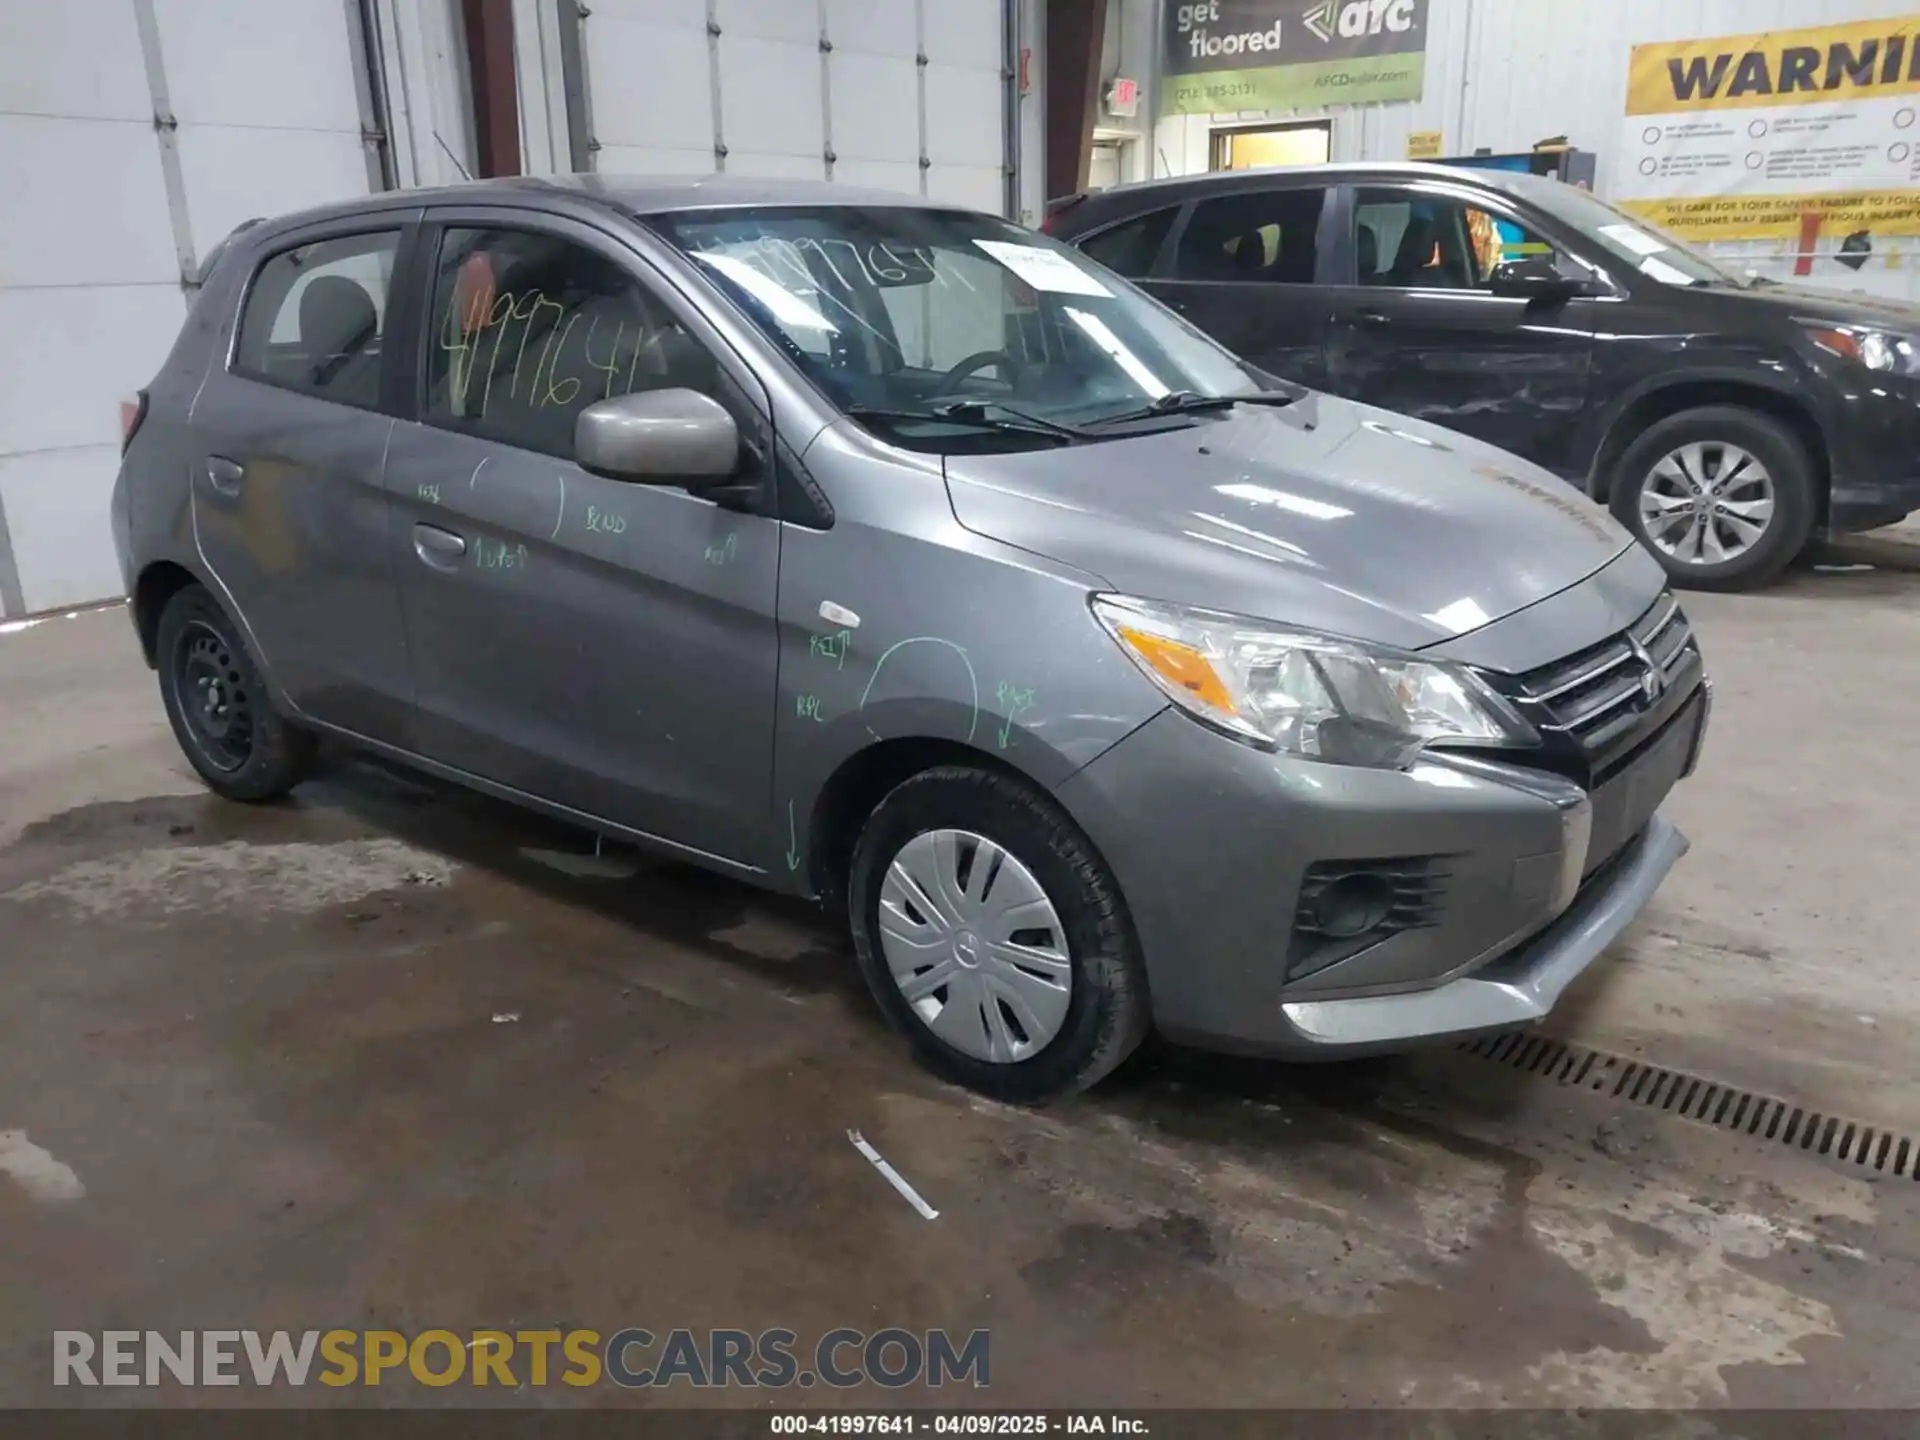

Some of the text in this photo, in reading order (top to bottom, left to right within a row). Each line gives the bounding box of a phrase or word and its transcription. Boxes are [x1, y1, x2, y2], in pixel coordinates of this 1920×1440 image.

[1178, 0, 1220, 31] get
[1189, 20, 1282, 57] floored
[1667, 36, 1920, 101] WARNI
